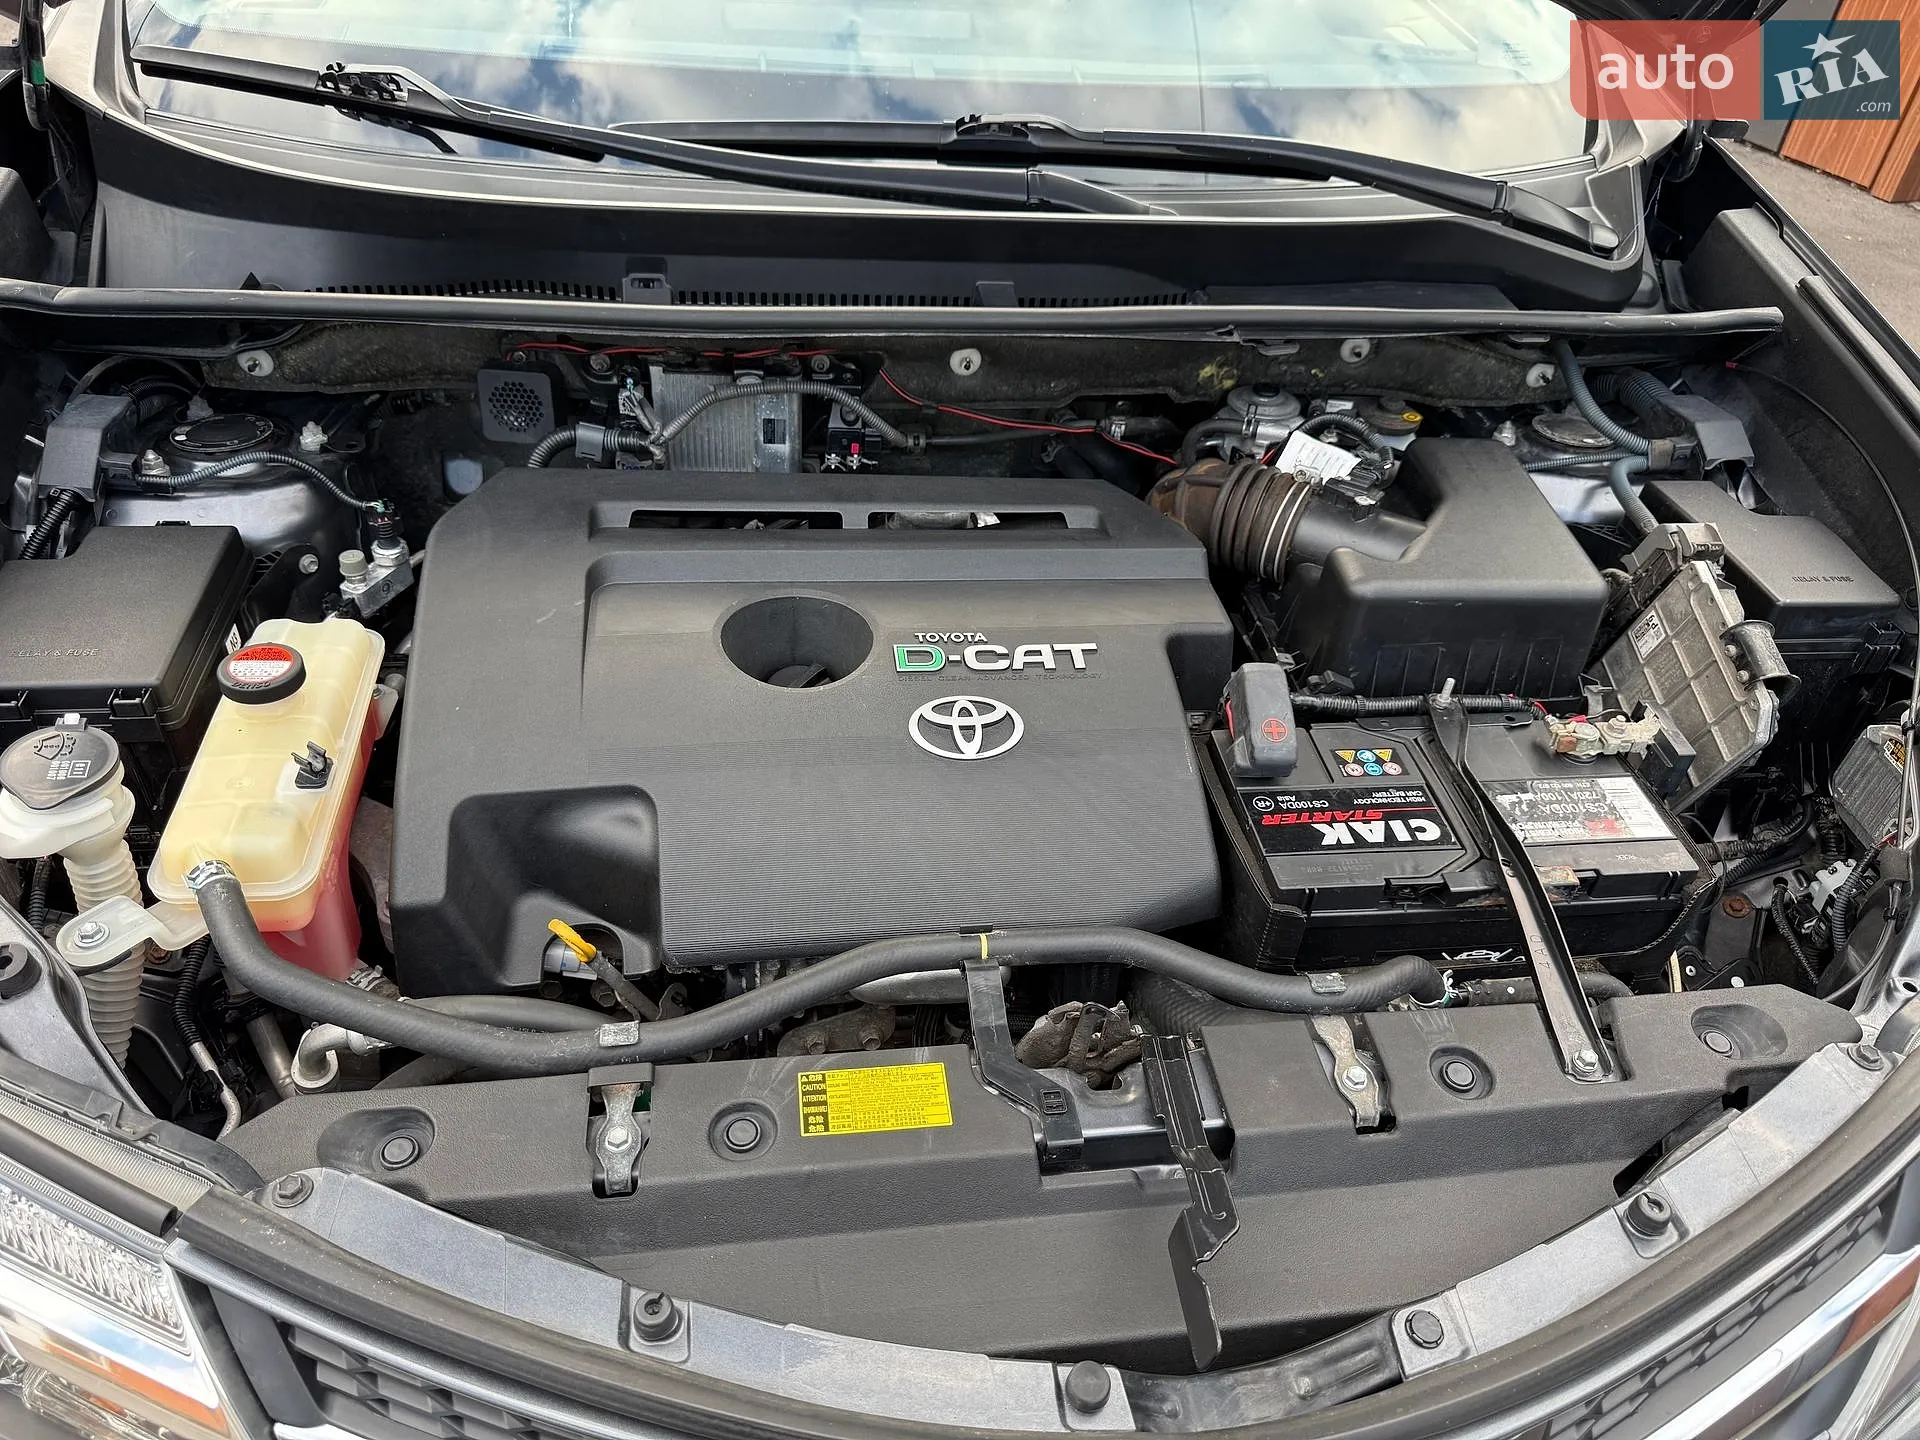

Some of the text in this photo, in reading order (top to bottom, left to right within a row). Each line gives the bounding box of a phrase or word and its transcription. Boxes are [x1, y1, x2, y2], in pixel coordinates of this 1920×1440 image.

[914, 632, 988, 643] TOYOTA
[65, 647, 100, 657] FUSE
[893, 642, 1098, 673] D-CAT
[1278, 799, 1330, 809] CS100DA
[1353, 797, 1406, 805] TECHNOLOGY
[1537, 802, 1608, 814] CS100DA
[1262, 809, 1383, 825] STARTER
[1311, 818, 1441, 845] CIAK
[801, 1083, 827, 1091] CAUTION
[802, 1094, 827, 1103] ATTENTION
